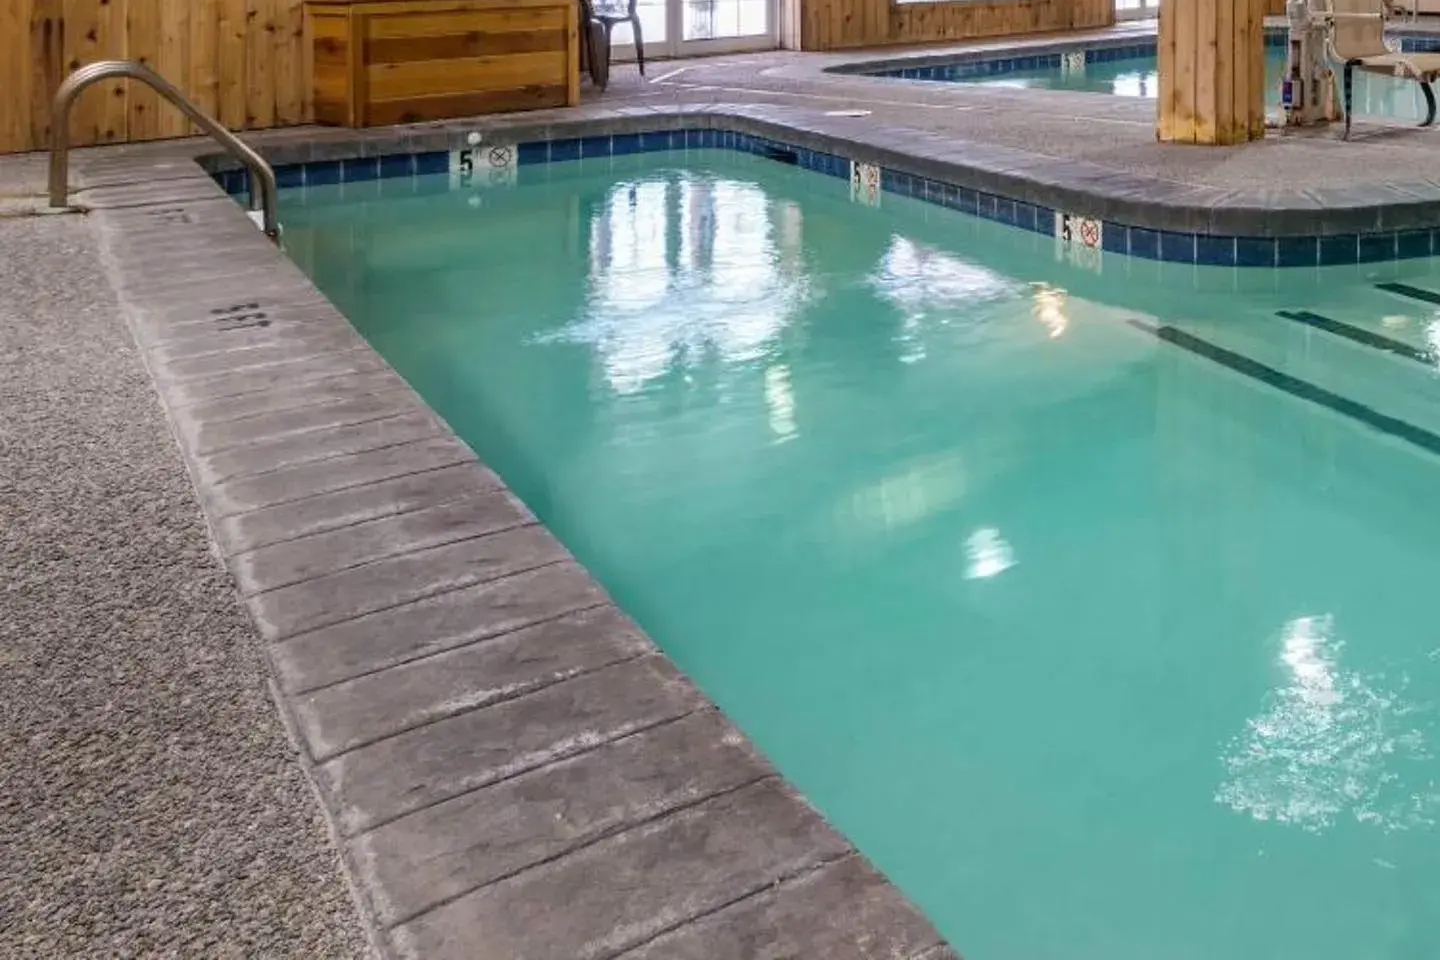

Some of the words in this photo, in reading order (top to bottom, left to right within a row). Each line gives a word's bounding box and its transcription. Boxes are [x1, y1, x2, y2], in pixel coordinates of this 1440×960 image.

[460, 149, 473, 172] 5
[854, 160, 861, 183] 5
[1063, 213, 1071, 240] 5
